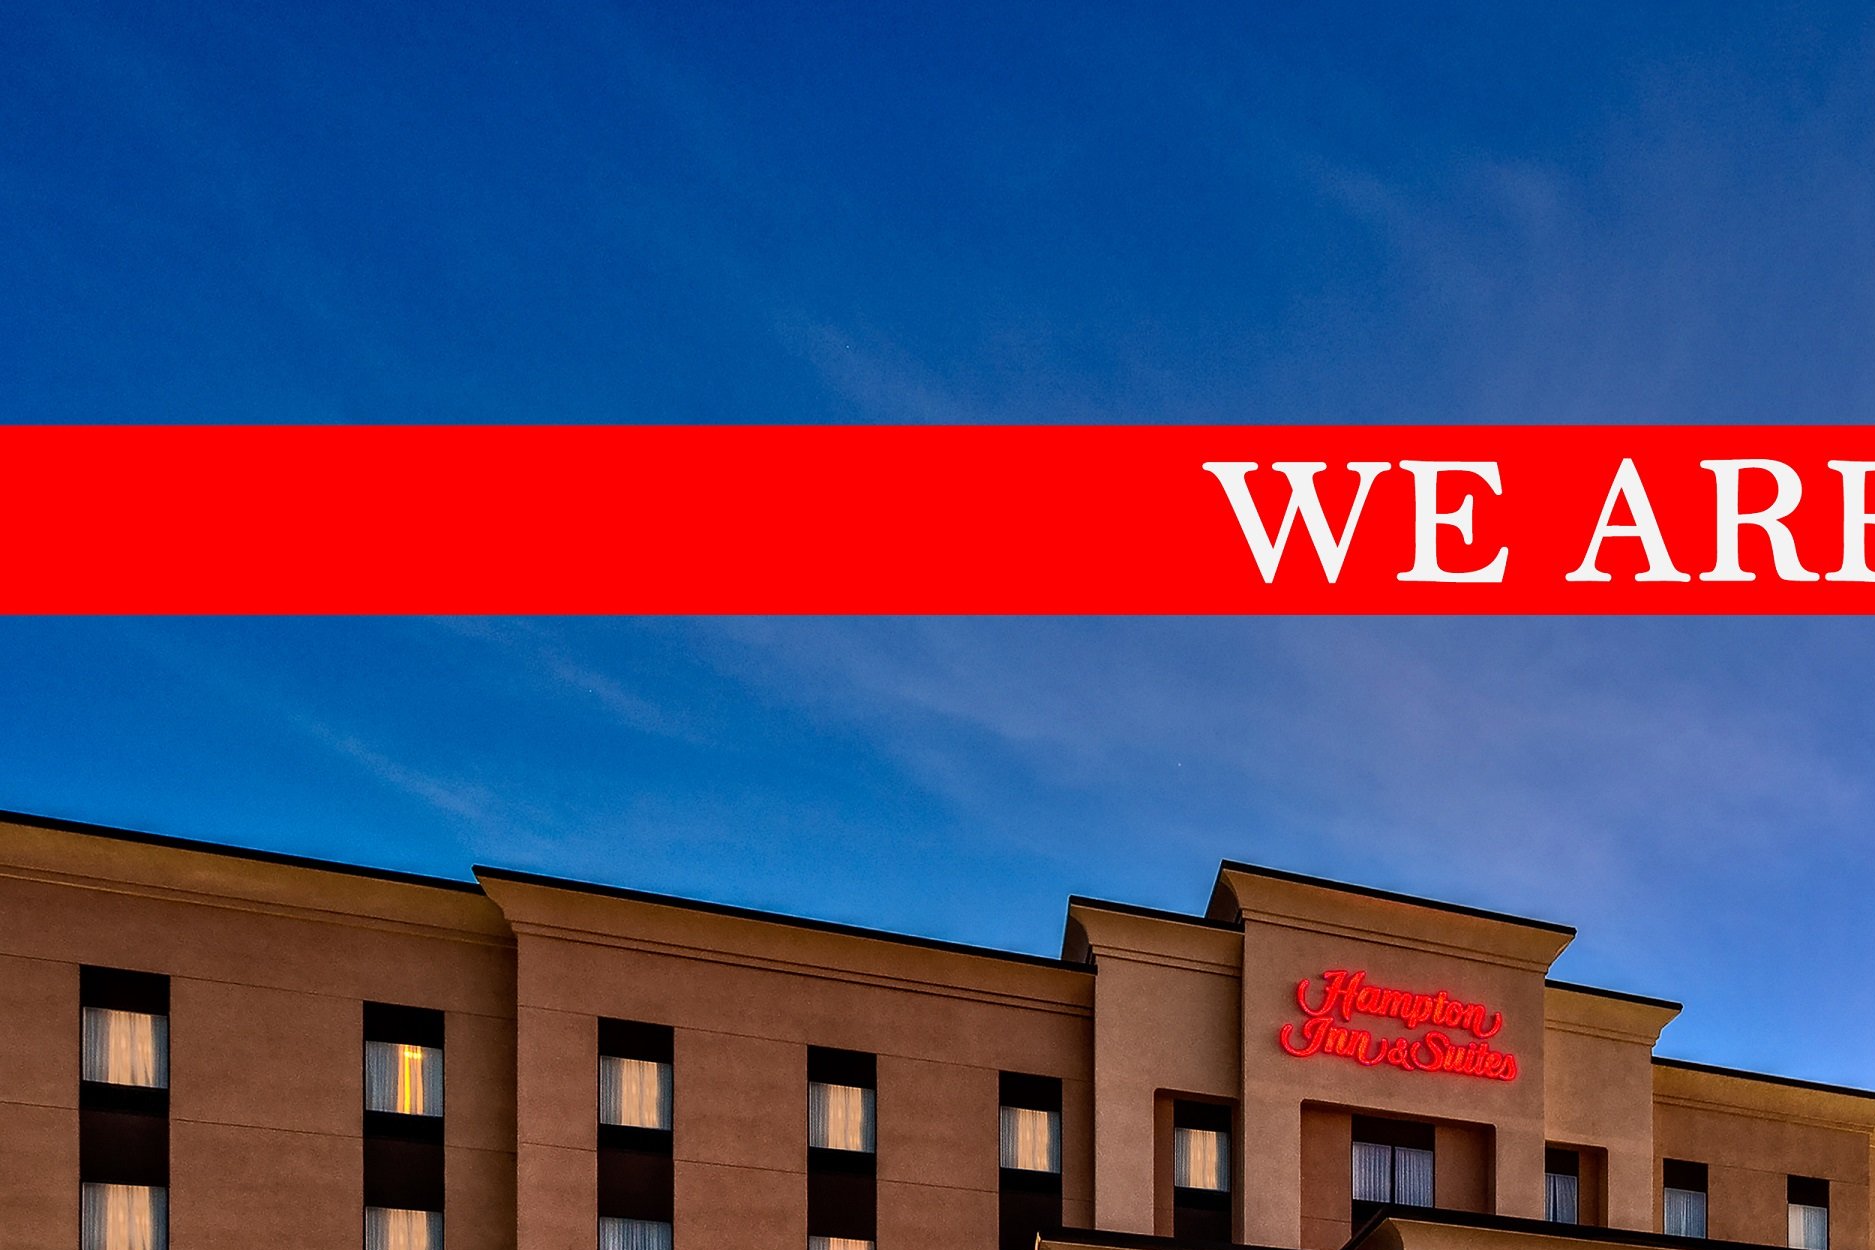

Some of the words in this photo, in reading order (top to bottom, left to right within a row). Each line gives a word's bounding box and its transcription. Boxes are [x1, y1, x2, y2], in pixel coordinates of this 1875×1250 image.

[1297, 970, 1503, 1039] Hampton
[1280, 1018, 1389, 1066] Inn
[1387, 1037, 1415, 1071] &
[1410, 1031, 1518, 1081] Suites
